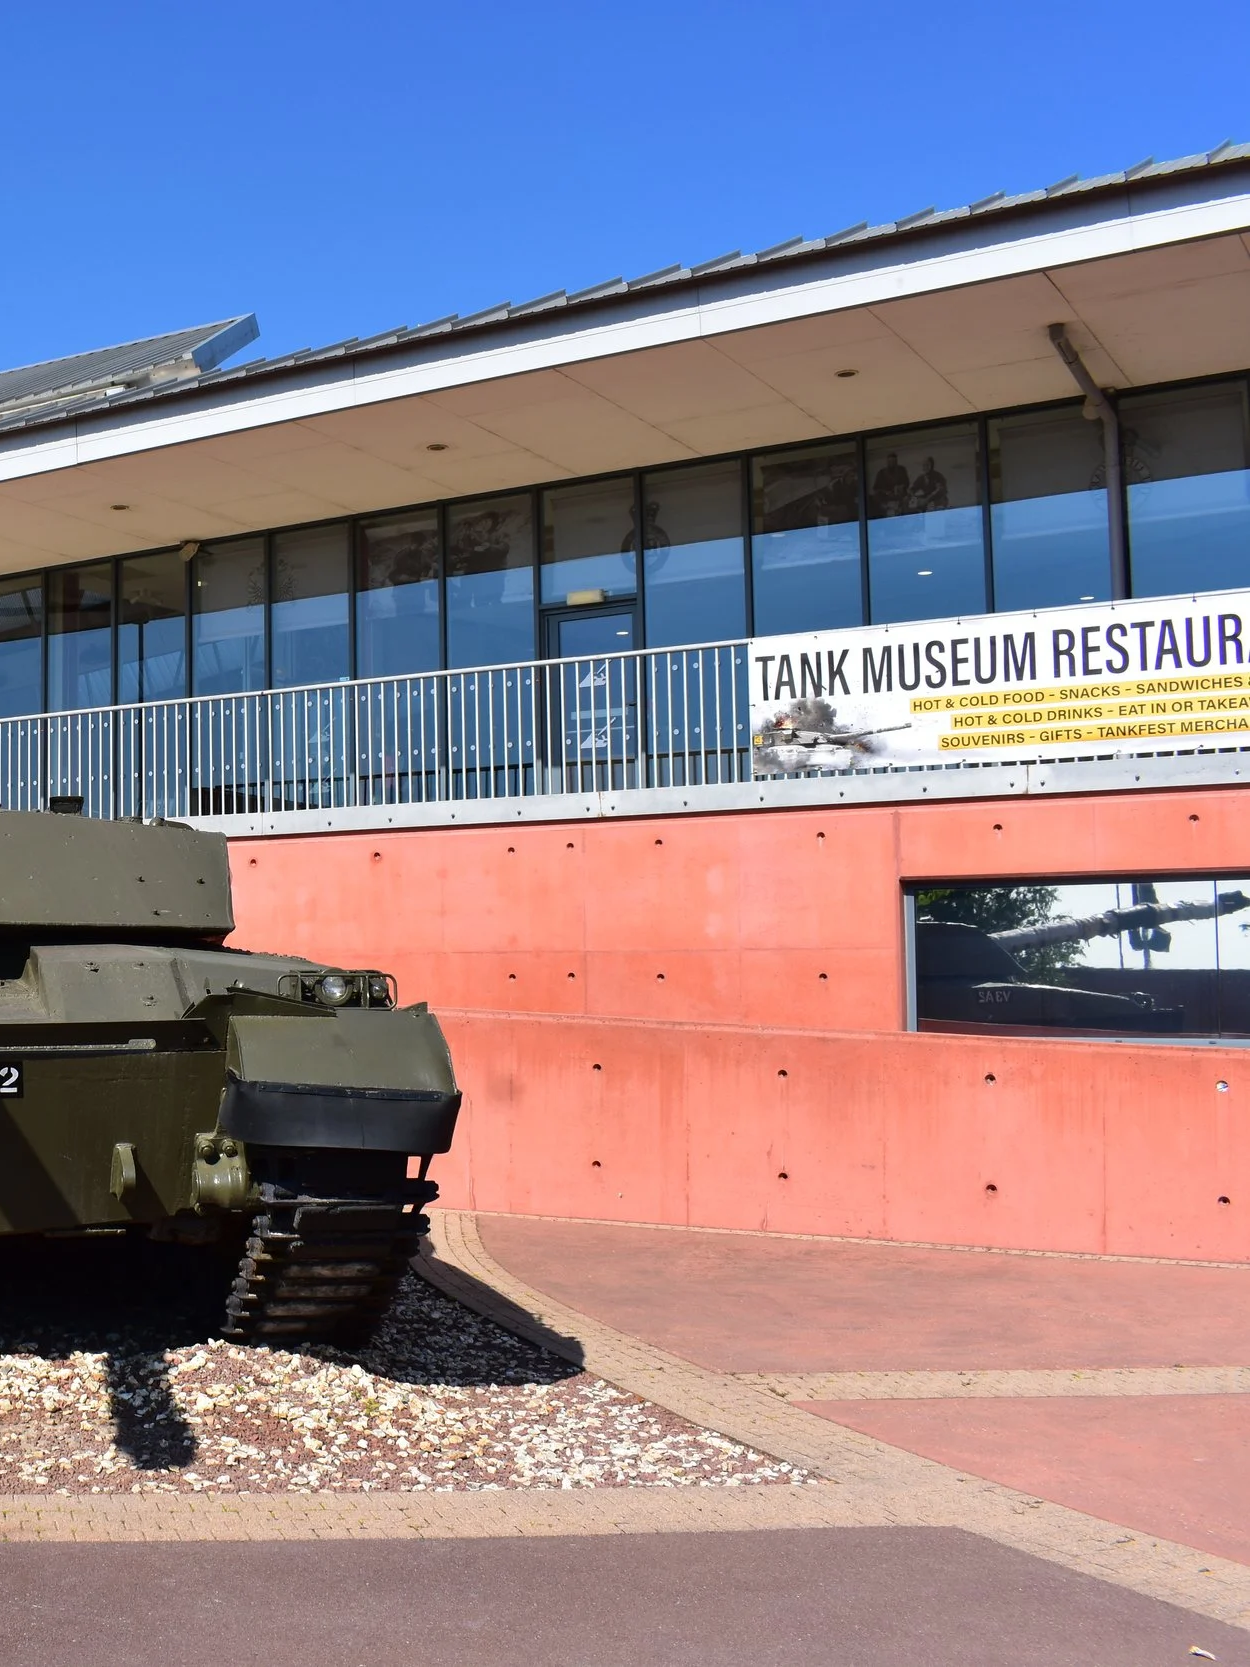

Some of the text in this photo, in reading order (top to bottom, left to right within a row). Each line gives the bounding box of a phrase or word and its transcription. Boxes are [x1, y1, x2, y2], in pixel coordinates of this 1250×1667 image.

[755, 613, 1250, 701] TANK MUSEUM RESTAUR
[913, 699, 942, 712] HOT
[945, 698, 955, 709] &
[959, 694, 999, 707] COLD
[1003, 691, 1045, 704] FOOD
[1059, 685, 1121, 700] SNACKS
[1136, 676, 1243, 694] SANDWICHES
[954, 716, 983, 727] HOT
[987, 714, 998, 726] &
[1002, 711, 1043, 724] COLD
[1047, 707, 1103, 721] DRINKS
[1119, 704, 1147, 716] EAT
[1151, 702, 1167, 714] IN
[1171, 700, 1193, 713] OR
[1198, 697, 1250, 711] TAKEA
[941, 732, 1025, 748] SOUVENIRS
[1039, 729, 1082, 742] GIFTS
[1097, 723, 1176, 738] TANKFEST
[1180, 718, 1249, 733] MERCHA
